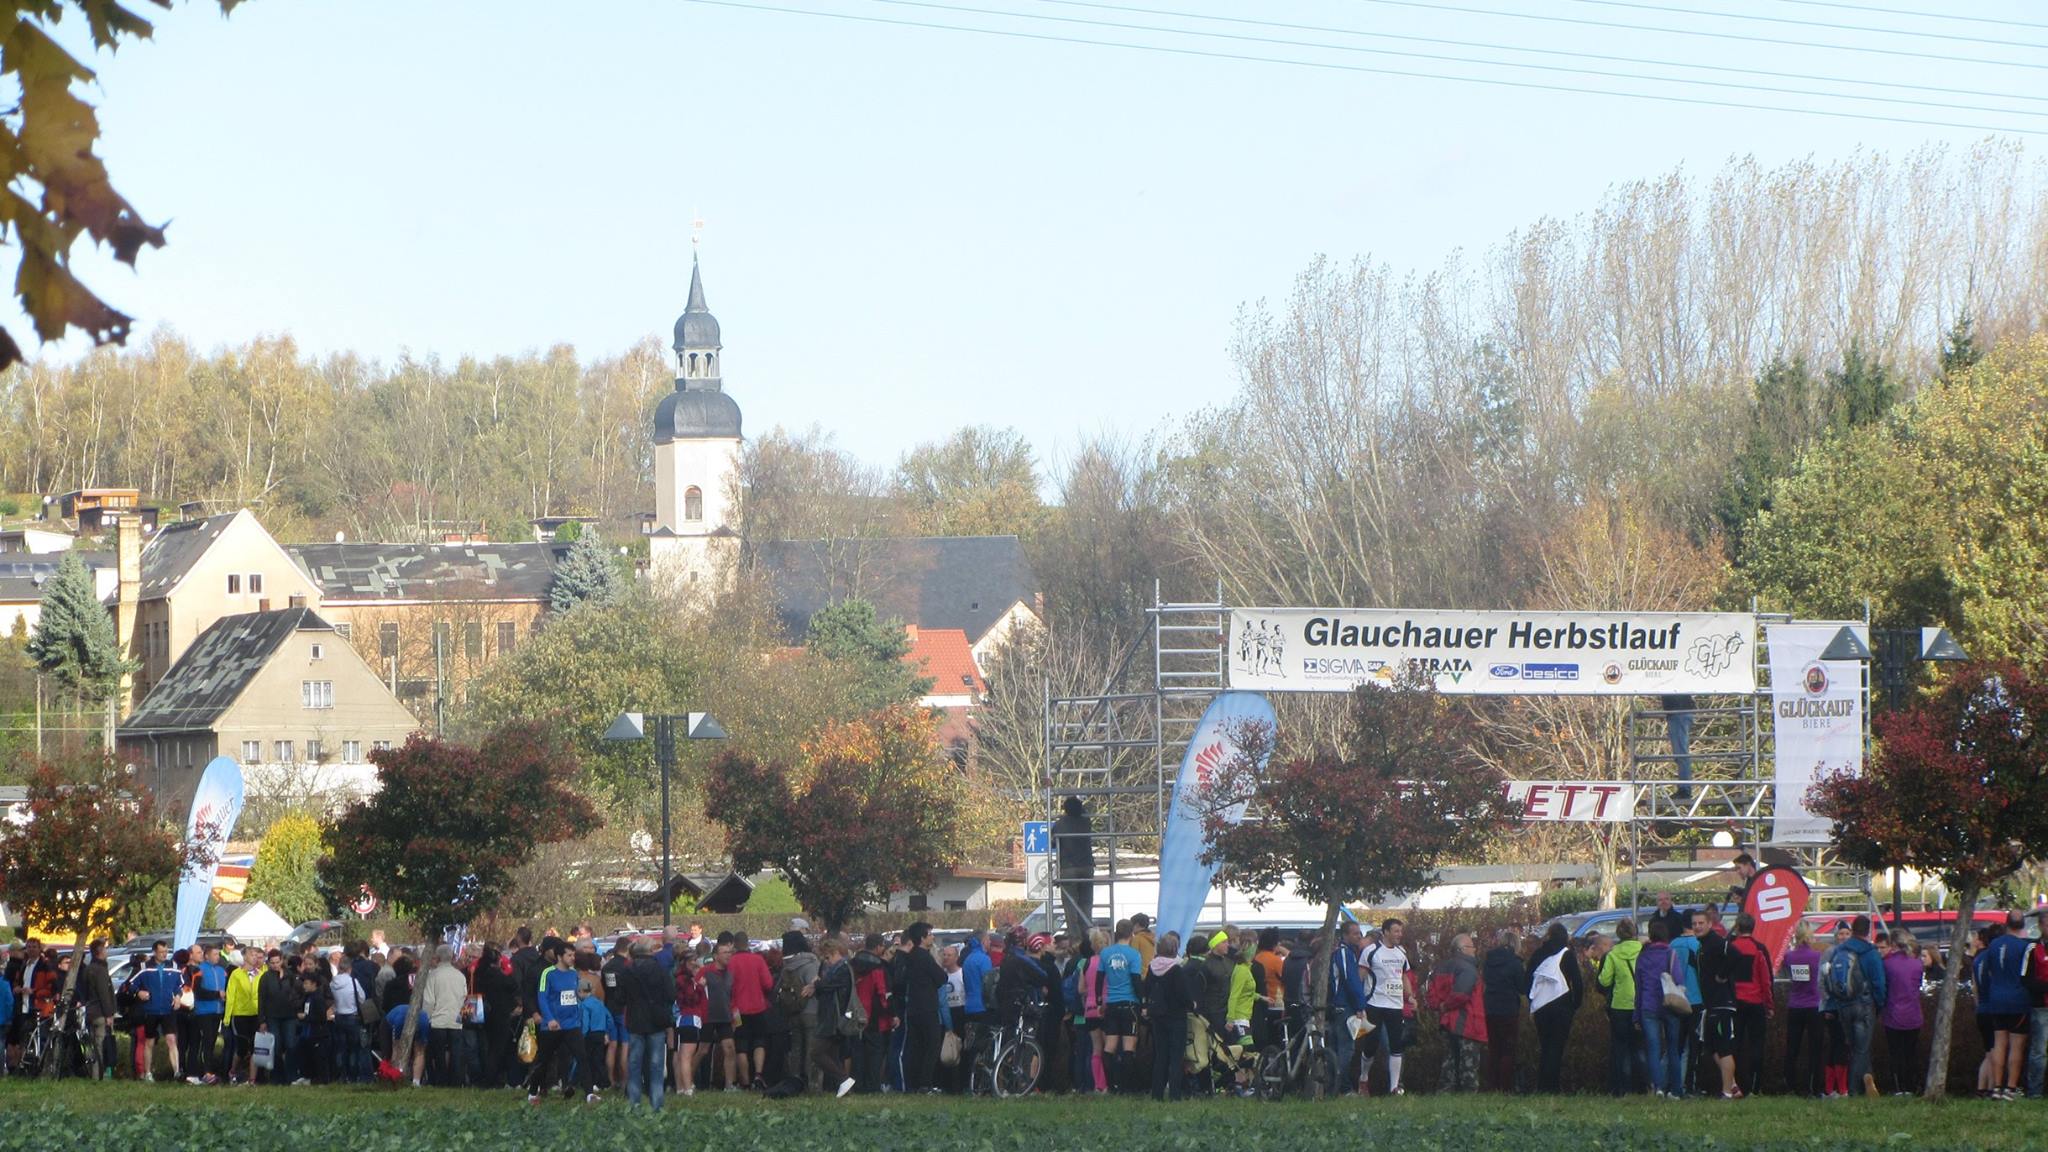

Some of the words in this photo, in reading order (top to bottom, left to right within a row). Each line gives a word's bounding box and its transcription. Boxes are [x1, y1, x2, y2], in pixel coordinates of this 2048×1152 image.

[1304, 617, 1498, 649] Glauchauer
[1508, 621, 1681, 650] Herbstlauf
[1319, 658, 1365, 673] SIGMA
[1495, 665, 1514, 676] Ford
[1522, 664, 1579, 679] besico
[1628, 657, 1679, 671] GLÜCKAUF
[1779, 698, 1854, 718] GLÜCKAUF
[1802, 719, 1831, 729] BIERE
[1502, 785, 1621, 820] ETT
